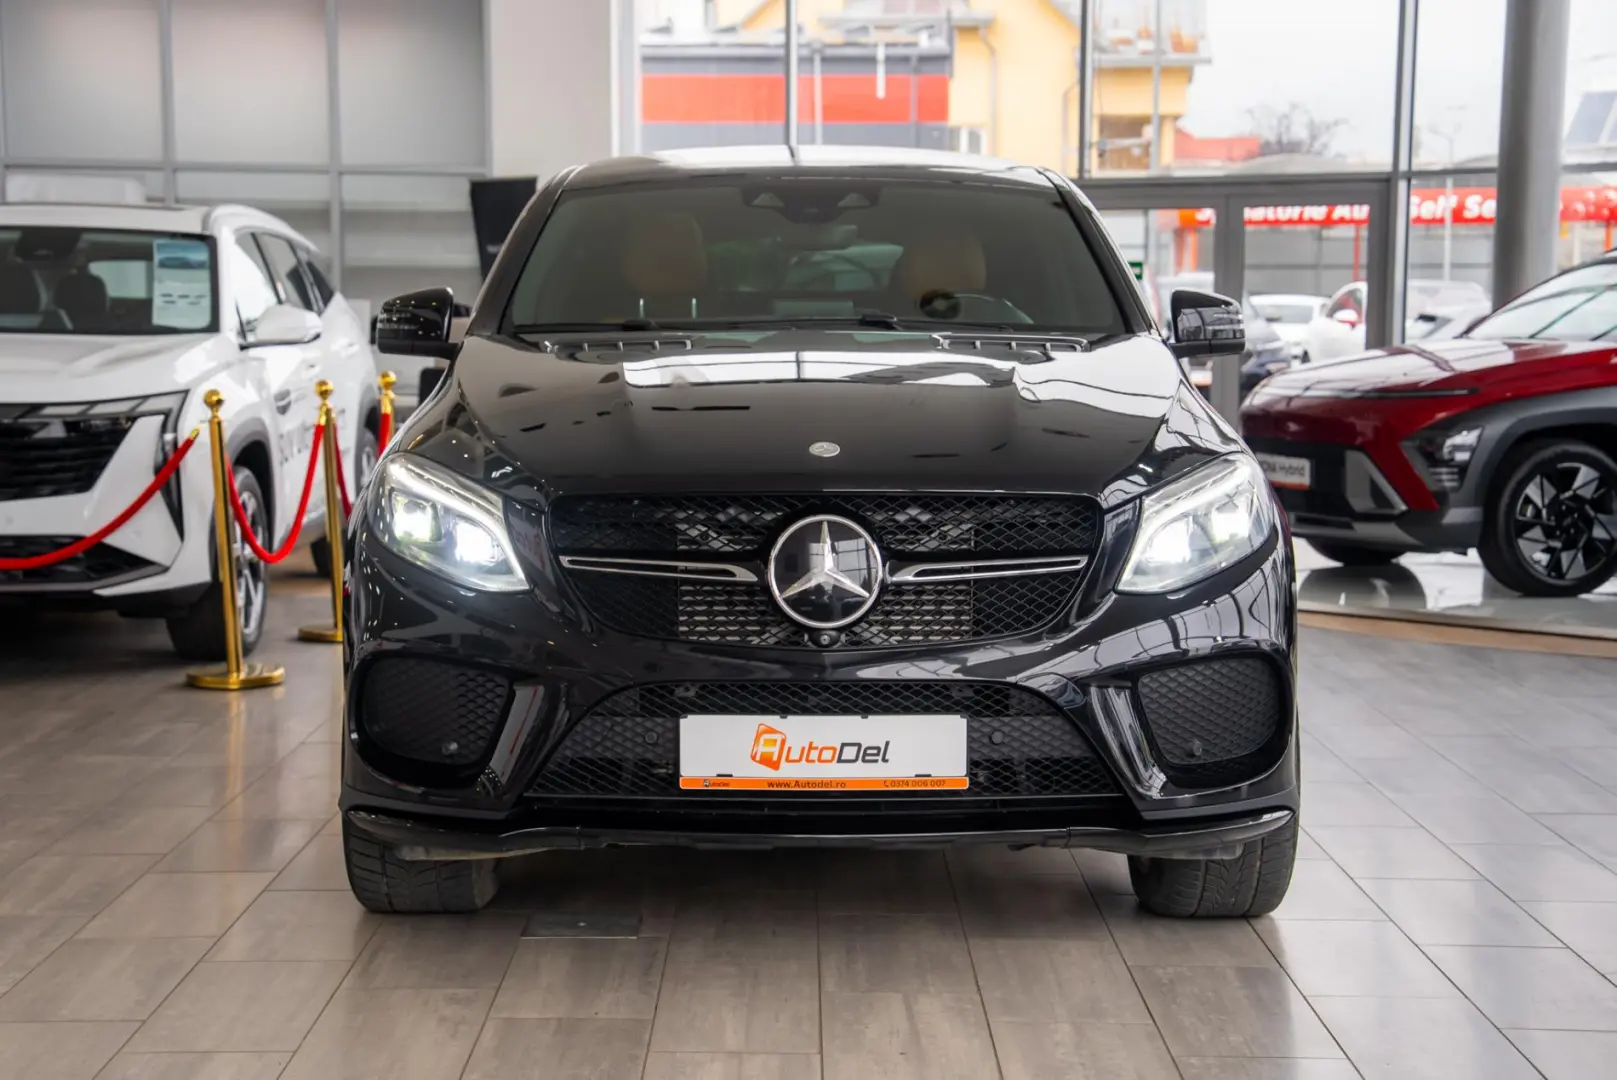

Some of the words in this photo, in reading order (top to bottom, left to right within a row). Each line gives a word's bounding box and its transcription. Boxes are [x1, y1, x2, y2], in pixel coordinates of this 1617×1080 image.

[753, 729, 890, 767] AutoDel
[767, 779, 847, 789] www.Autodel.ro
[890, 780, 910, 788] 0374
[911, 780, 928, 788] 006
[930, 779, 946, 788] 007
